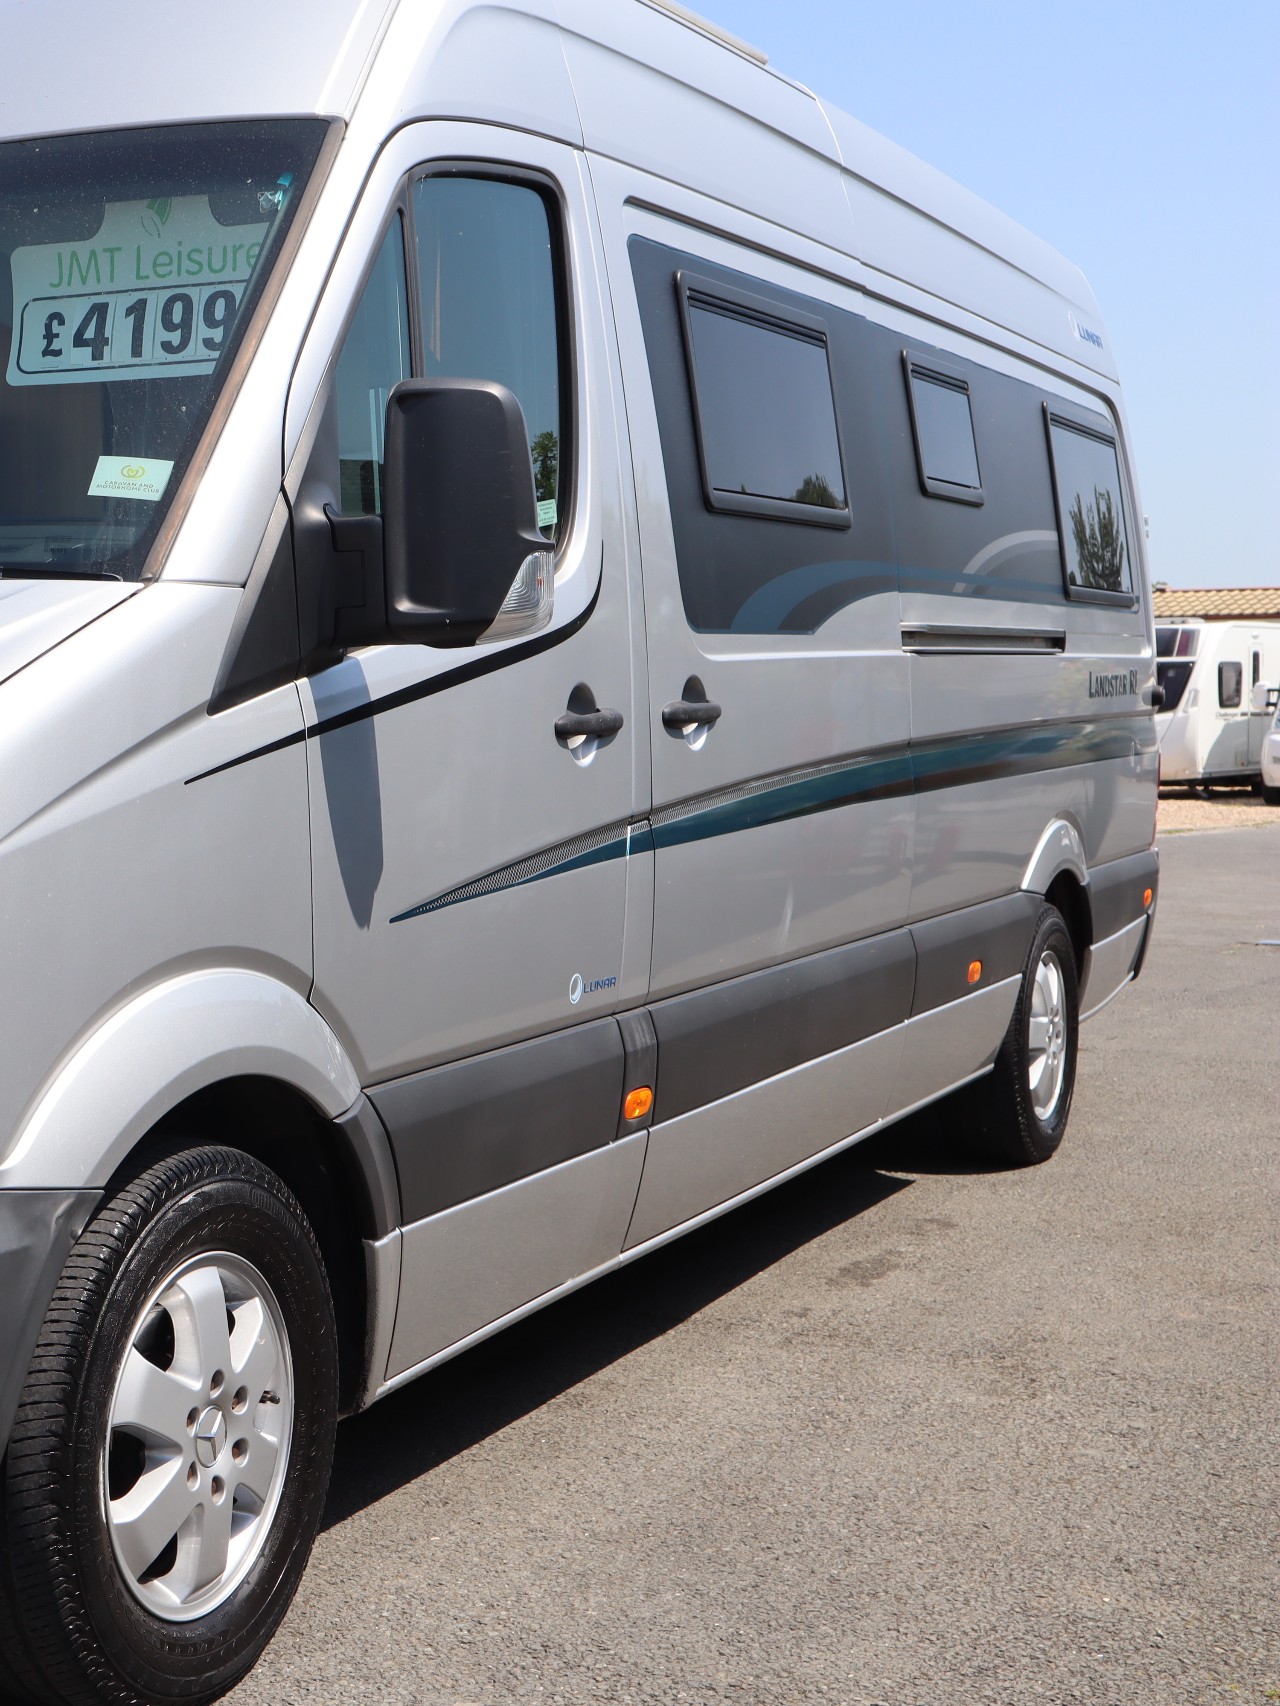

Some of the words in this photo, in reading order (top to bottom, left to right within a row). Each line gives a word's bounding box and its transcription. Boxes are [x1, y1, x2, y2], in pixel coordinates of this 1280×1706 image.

[49, 247, 122, 289] JMT
[135, 240, 262, 281] Leisure
[583, 976, 617, 994] LUNAR
